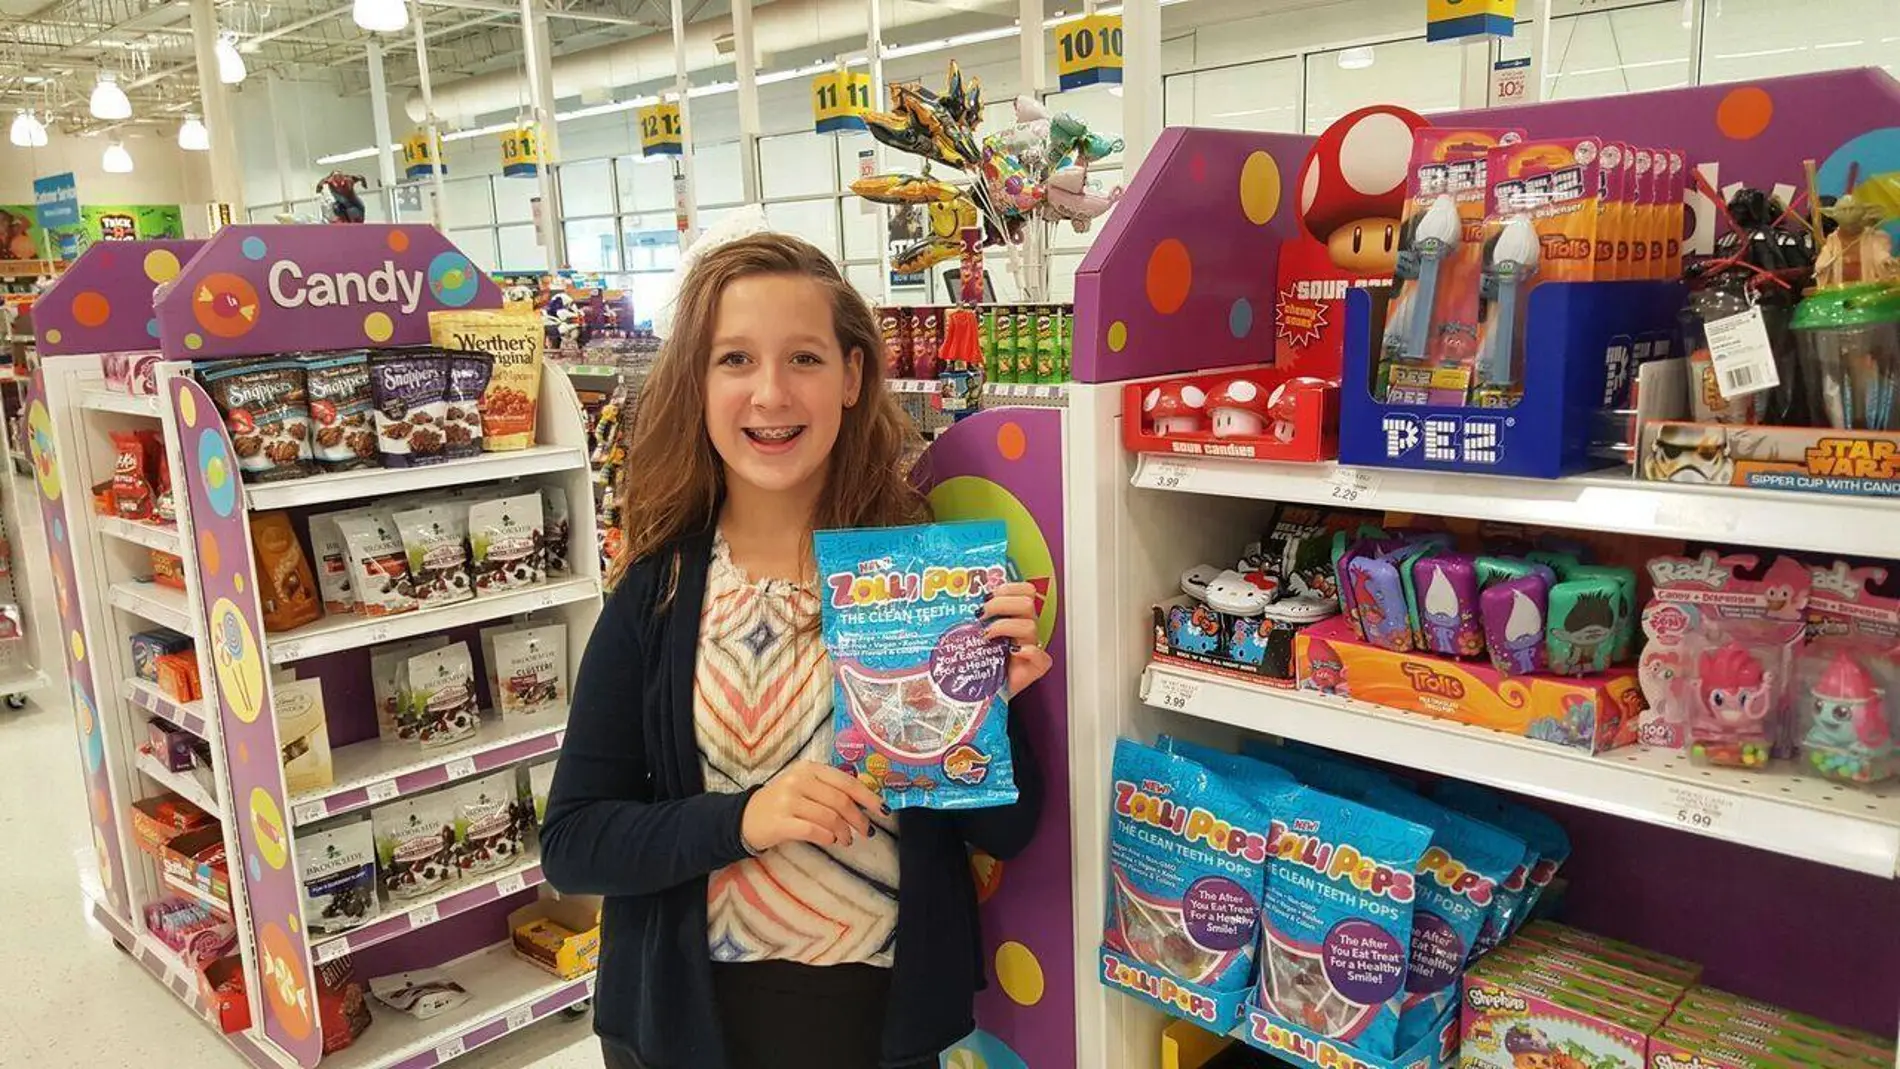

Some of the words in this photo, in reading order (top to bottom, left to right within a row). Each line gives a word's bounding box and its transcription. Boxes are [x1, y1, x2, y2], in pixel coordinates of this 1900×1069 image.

[1060, 24, 1094, 62] 10
[817, 83, 837, 109] 11
[847, 82, 870, 108] 11
[641, 116, 658, 138] 12
[502, 139, 517, 159] 13
[1495, 167, 1585, 212] PEZ
[268, 259, 424, 315] Candy
[1297, 280, 1349, 299] SOUR
[454, 333, 537, 351] Werther's
[493, 351, 535, 367] riginal
[384, 367, 439, 391] Snappers
[229, 382, 292, 406] Snappers
[1382, 417, 1498, 463] PEZ
[1807, 438, 1898, 458] STAR
[1806, 458, 1900, 479] WARS
[1332, 486, 1358, 501] 2.29
[1752, 474, 1795, 487] SIPPER
[1797, 476, 1824, 488] CUP
[1826, 479, 1860, 491] WITH
[1863, 481, 1900, 493] CAND
[1651, 556, 1728, 588] Radz
[1812, 566, 1860, 599] adz
[840, 612, 865, 625] THE
[867, 606, 913, 624] CLEAN
[915, 602, 955, 618] TEETH
[1163, 695, 1186, 708] 3.99
[1676, 809, 1712, 828] 5.99
[1117, 820, 1138, 837] THE
[1137, 829, 1174, 852] CLEAN
[1176, 844, 1215, 866] TEETH
[1217, 859, 1253, 879] POPS
[1199, 889, 1217, 901] The
[1218, 893, 1244, 904] After
[1279, 866, 1316, 893] CLEAN
[1316, 881, 1357, 907] TEETH
[1359, 898, 1400, 921] POPS
[1190, 899, 1209, 911] You
[1210, 903, 1228, 913] Eat
[1229, 904, 1255, 915] Treat
[1433, 892, 1473, 922] POPS
[1190, 910, 1207, 921] For
[1208, 914, 1215, 922] a
[1216, 913, 1255, 928] Healthy
[1206, 922, 1239, 935] Smile!
[1339, 934, 1359, 947] The
[1361, 936, 1389, 951] After
[1422, 928, 1453, 947] After
[1331, 944, 1351, 958] You
[1352, 947, 1370, 960] Eat
[1370, 949, 1401, 963] Treat
[1412, 950, 1457, 974] Healthy
[1430, 945, 1460, 962] Treat
[1330, 956, 1347, 969] For
[1348, 961, 1355, 970] a
[1356, 961, 1402, 977] Healthy
[1346, 970, 1383, 985] Smile!
